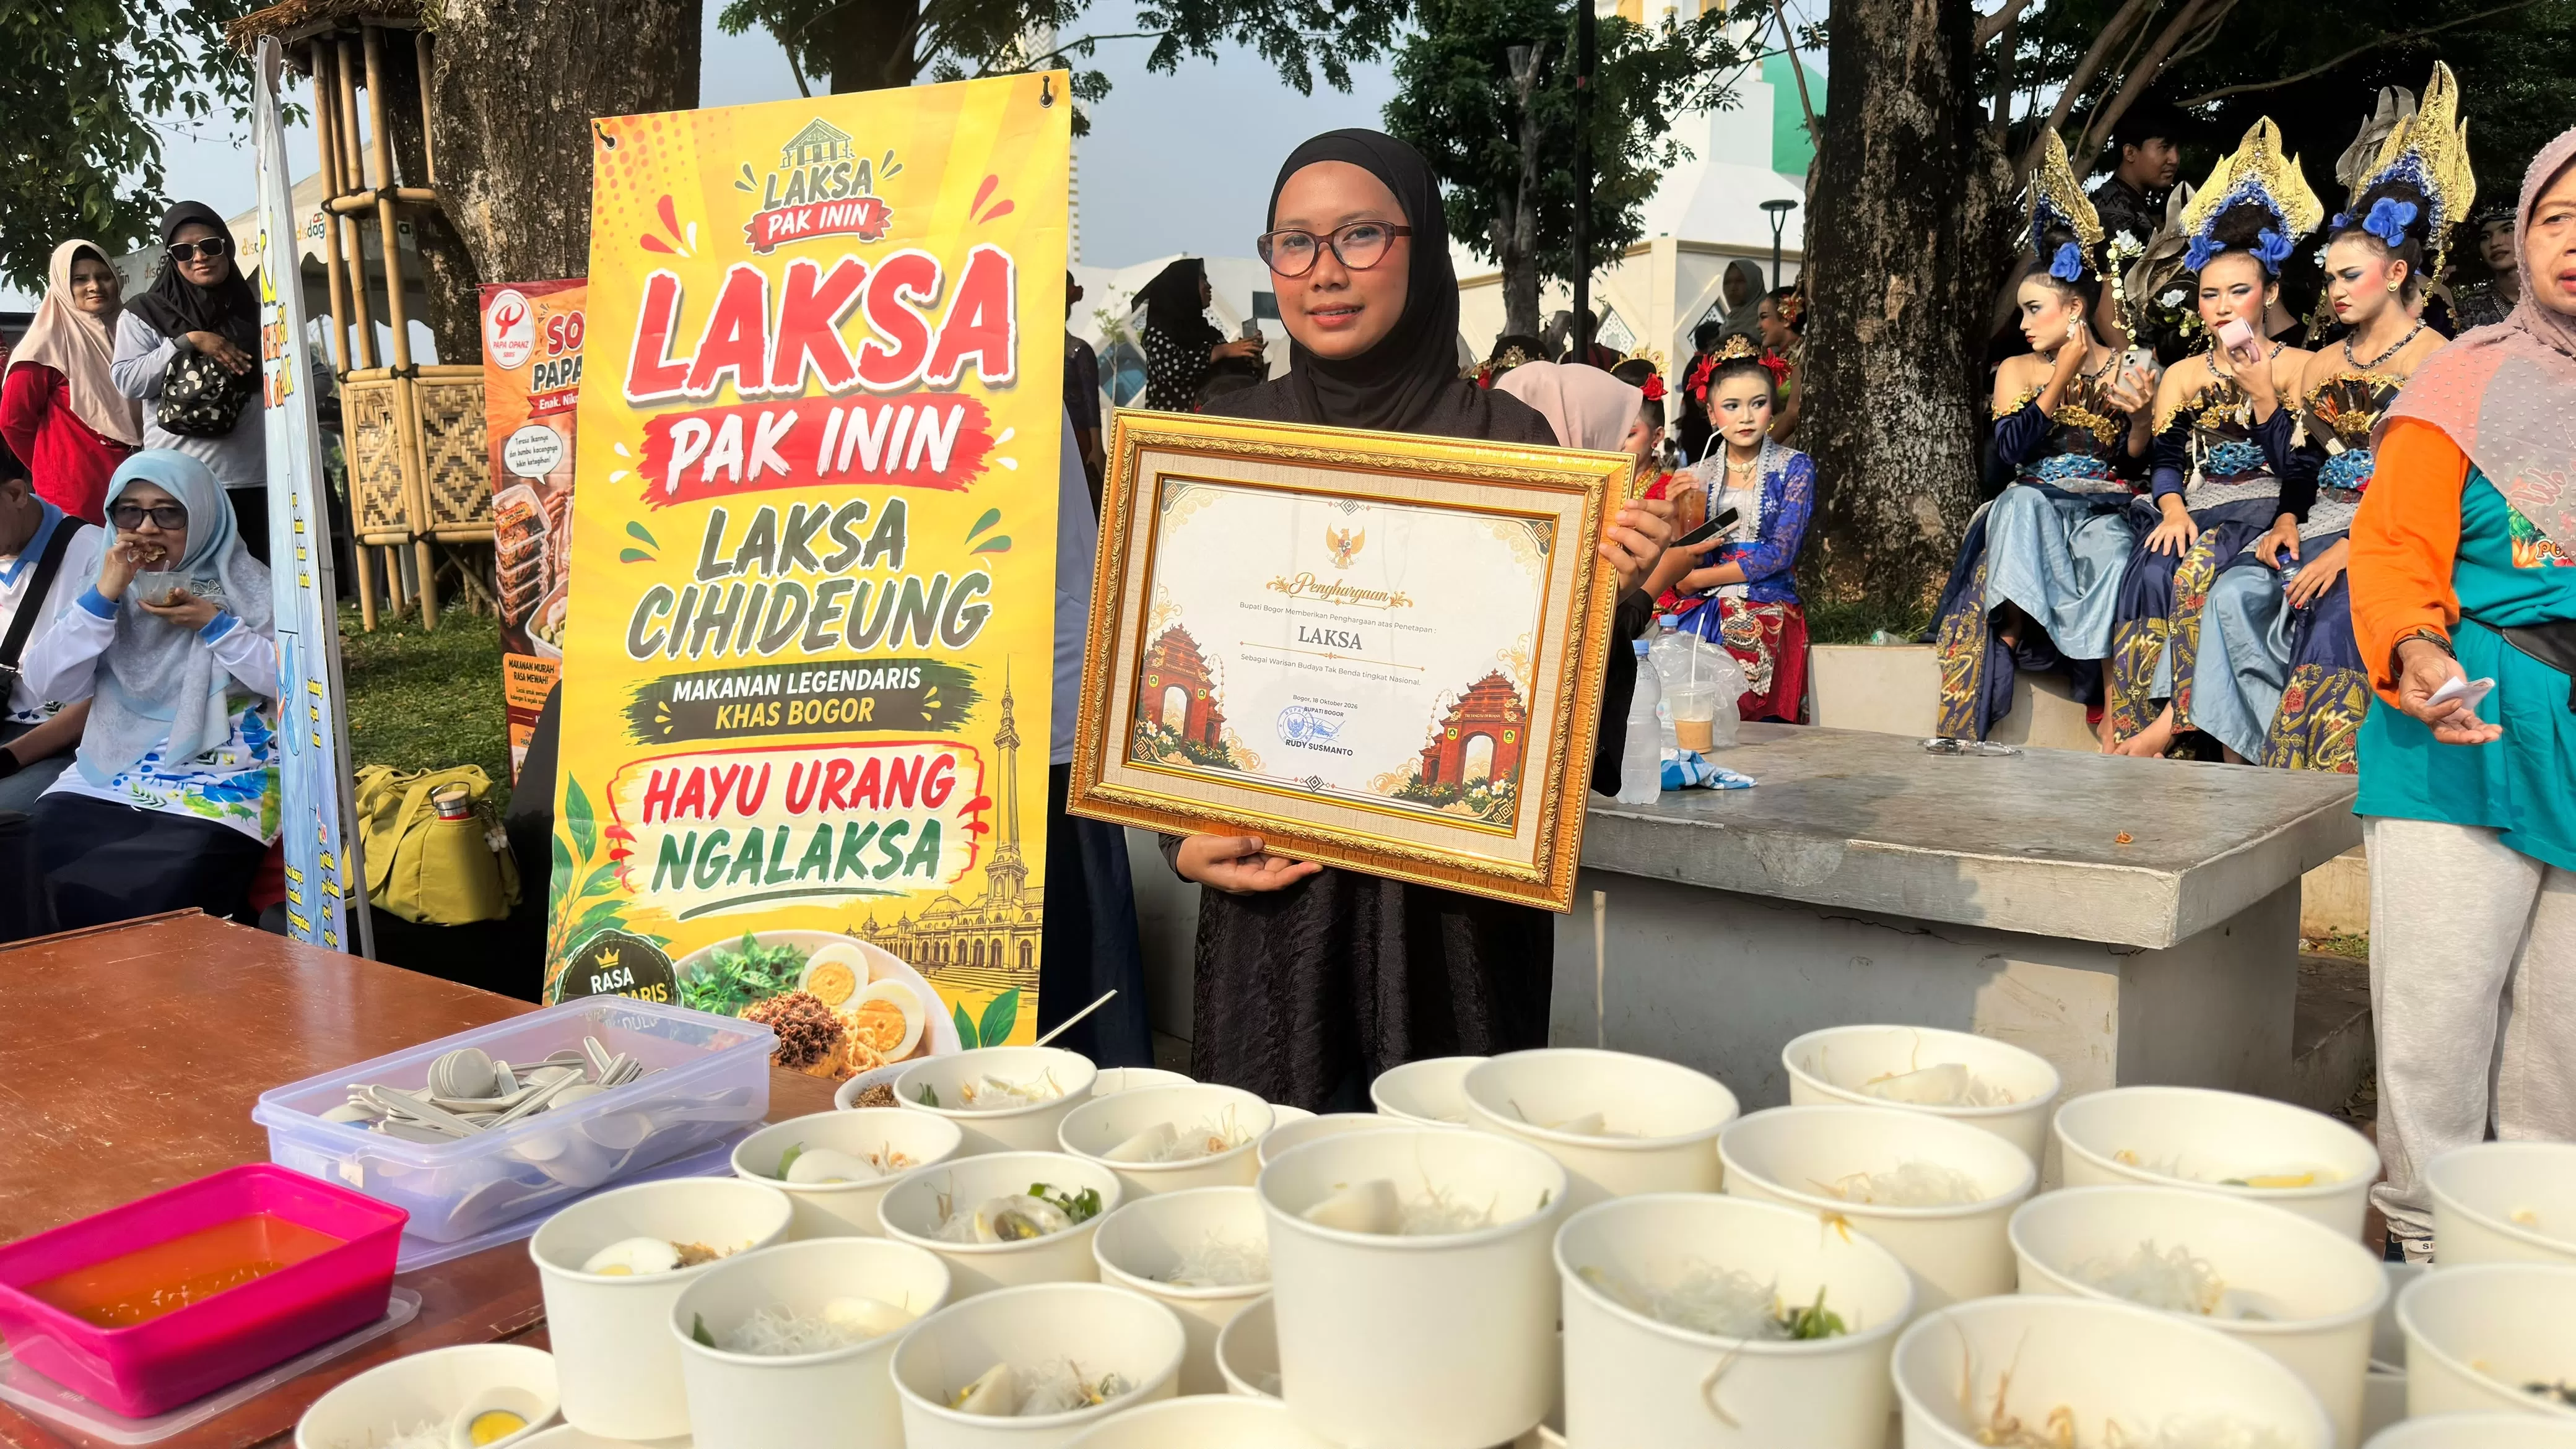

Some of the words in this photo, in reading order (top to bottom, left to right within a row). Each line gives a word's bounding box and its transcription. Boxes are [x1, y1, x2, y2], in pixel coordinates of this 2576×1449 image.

[763, 159, 873, 211] LAKSA
[767, 208, 812, 240] PAK
[818, 202, 870, 230] ININ
[626, 246, 1017, 404] LAKSA
[539, 396, 561, 410] Enak.
[516, 460, 527, 468] bikin
[517, 448, 533, 457] bumbu
[533, 445, 559, 455] kacangnya
[665, 409, 798, 494] PAK
[817, 404, 965, 477] ININ
[695, 497, 908, 583] LAKSA
[1288, 572, 1390, 604] Penghargaan
[625, 568, 993, 661] CIHIDEUNG
[1240, 602, 1262, 612] Bupati
[1263, 604, 1284, 615] Bogor
[1286, 607, 1328, 620] Memberikan
[1329, 614, 1377, 627] Penghargaan
[1378, 620, 1393, 628] atas
[1395, 622, 1433, 635] Penetapan
[1298, 625, 1363, 650] LAKSA
[509, 659, 533, 671] MAKANAN
[534, 662, 555, 674] MURAH
[513, 672, 526, 681] RASA
[1240, 653, 1268, 664] Sebagai
[1269, 657, 1297, 668] Warisan
[1298, 661, 1323, 672] Budaya
[1325, 664, 1337, 673] Tak
[1338, 667, 1361, 678] Benda
[1362, 669, 1388, 682] tingkat
[1389, 674, 1421, 685] Nasional.
[674, 673, 783, 703] MAKANAN
[787, 667, 921, 695] LEGENDARIS
[1293, 695, 1312, 703] Bogor,
[1320, 698, 1343, 707] Oktober
[715, 700, 781, 730] KHAS
[788, 695, 875, 723] BOGOR
[1304, 706, 1323, 714] BUPATI
[1324, 709, 1344, 717] BOGOR
[1286, 739, 1307, 749] RUDY
[1308, 742, 1354, 757] SUSMANTO
[643, 761, 772, 825] HAYU
[785, 752, 955, 814] URANG
[650, 818, 940, 894] NGALAKSA
[590, 967, 635, 994] RASA
